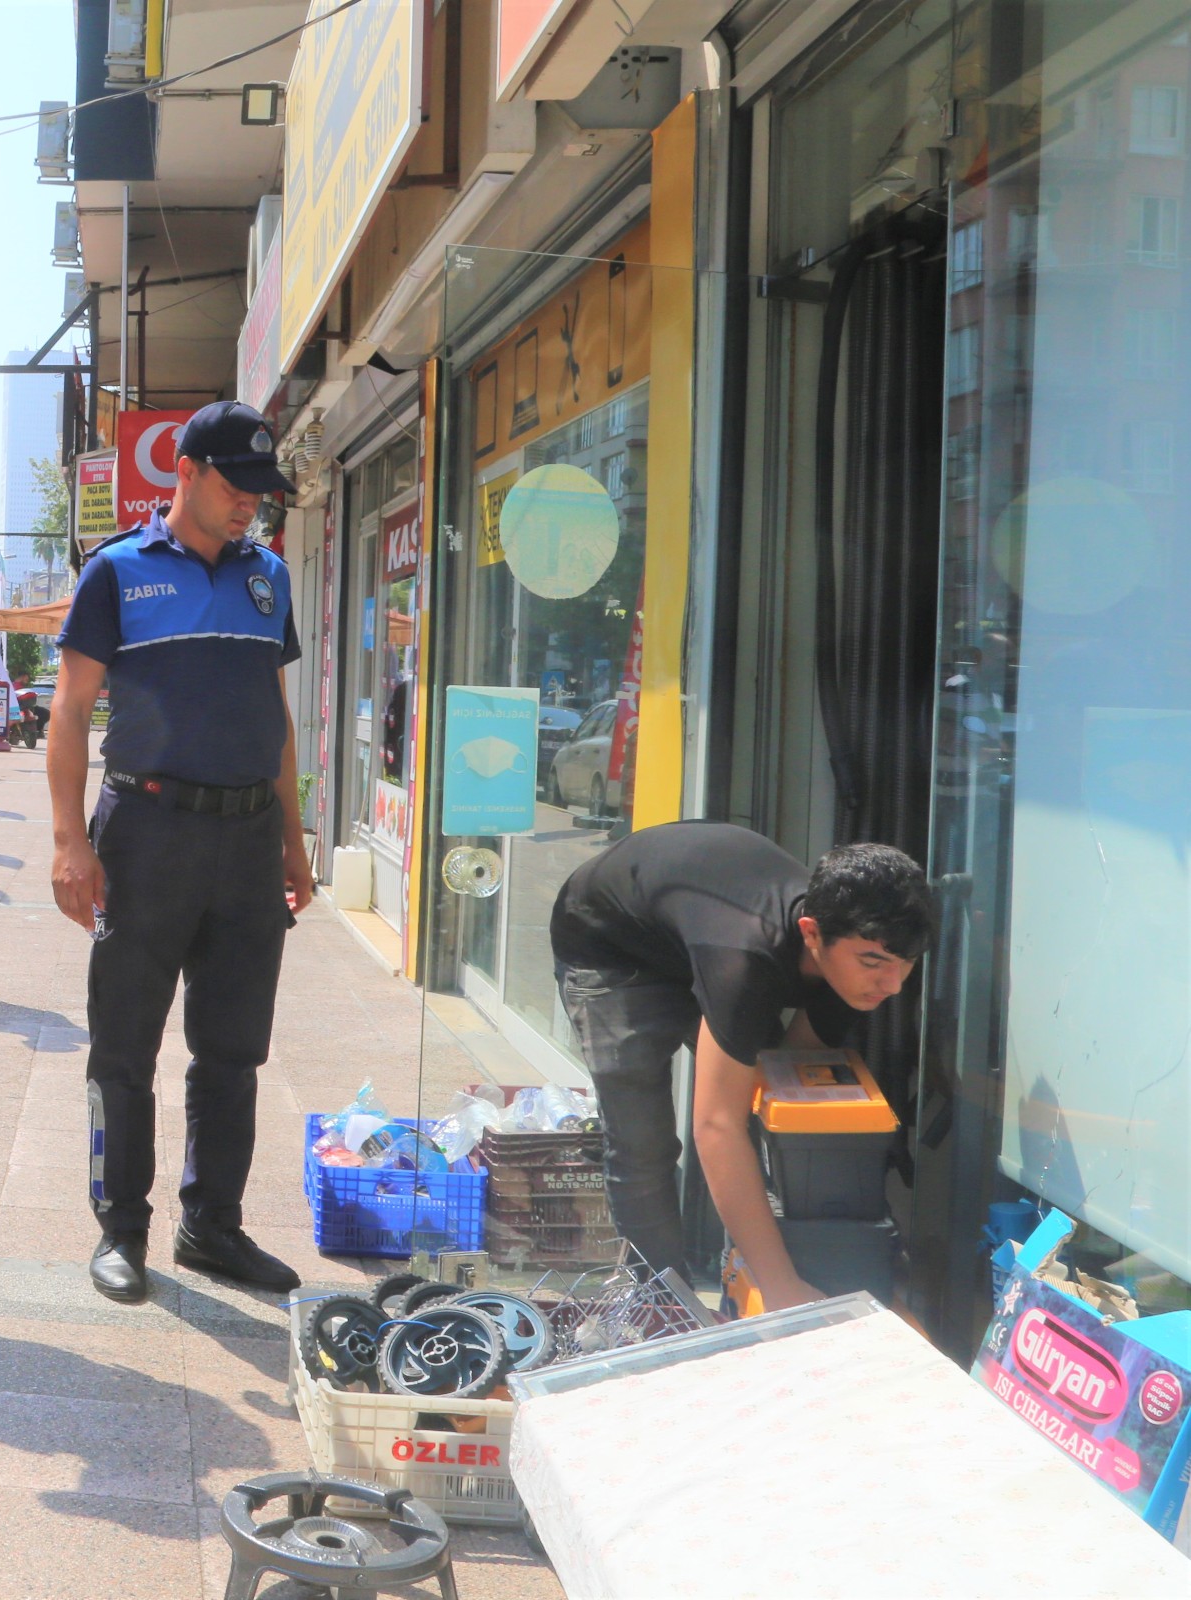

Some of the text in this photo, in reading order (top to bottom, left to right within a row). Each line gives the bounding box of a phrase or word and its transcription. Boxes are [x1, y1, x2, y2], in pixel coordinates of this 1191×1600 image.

[123, 583, 178, 602] ZABITA
[110, 770, 137, 786] ZABITA
[1017, 1309, 1106, 1408] Güryan
[1150, 1385, 1175, 1402] Süper
[993, 1372, 1103, 1470] ISI CİHAZLARI
[391, 1436, 501, 1467] ÖZLER
